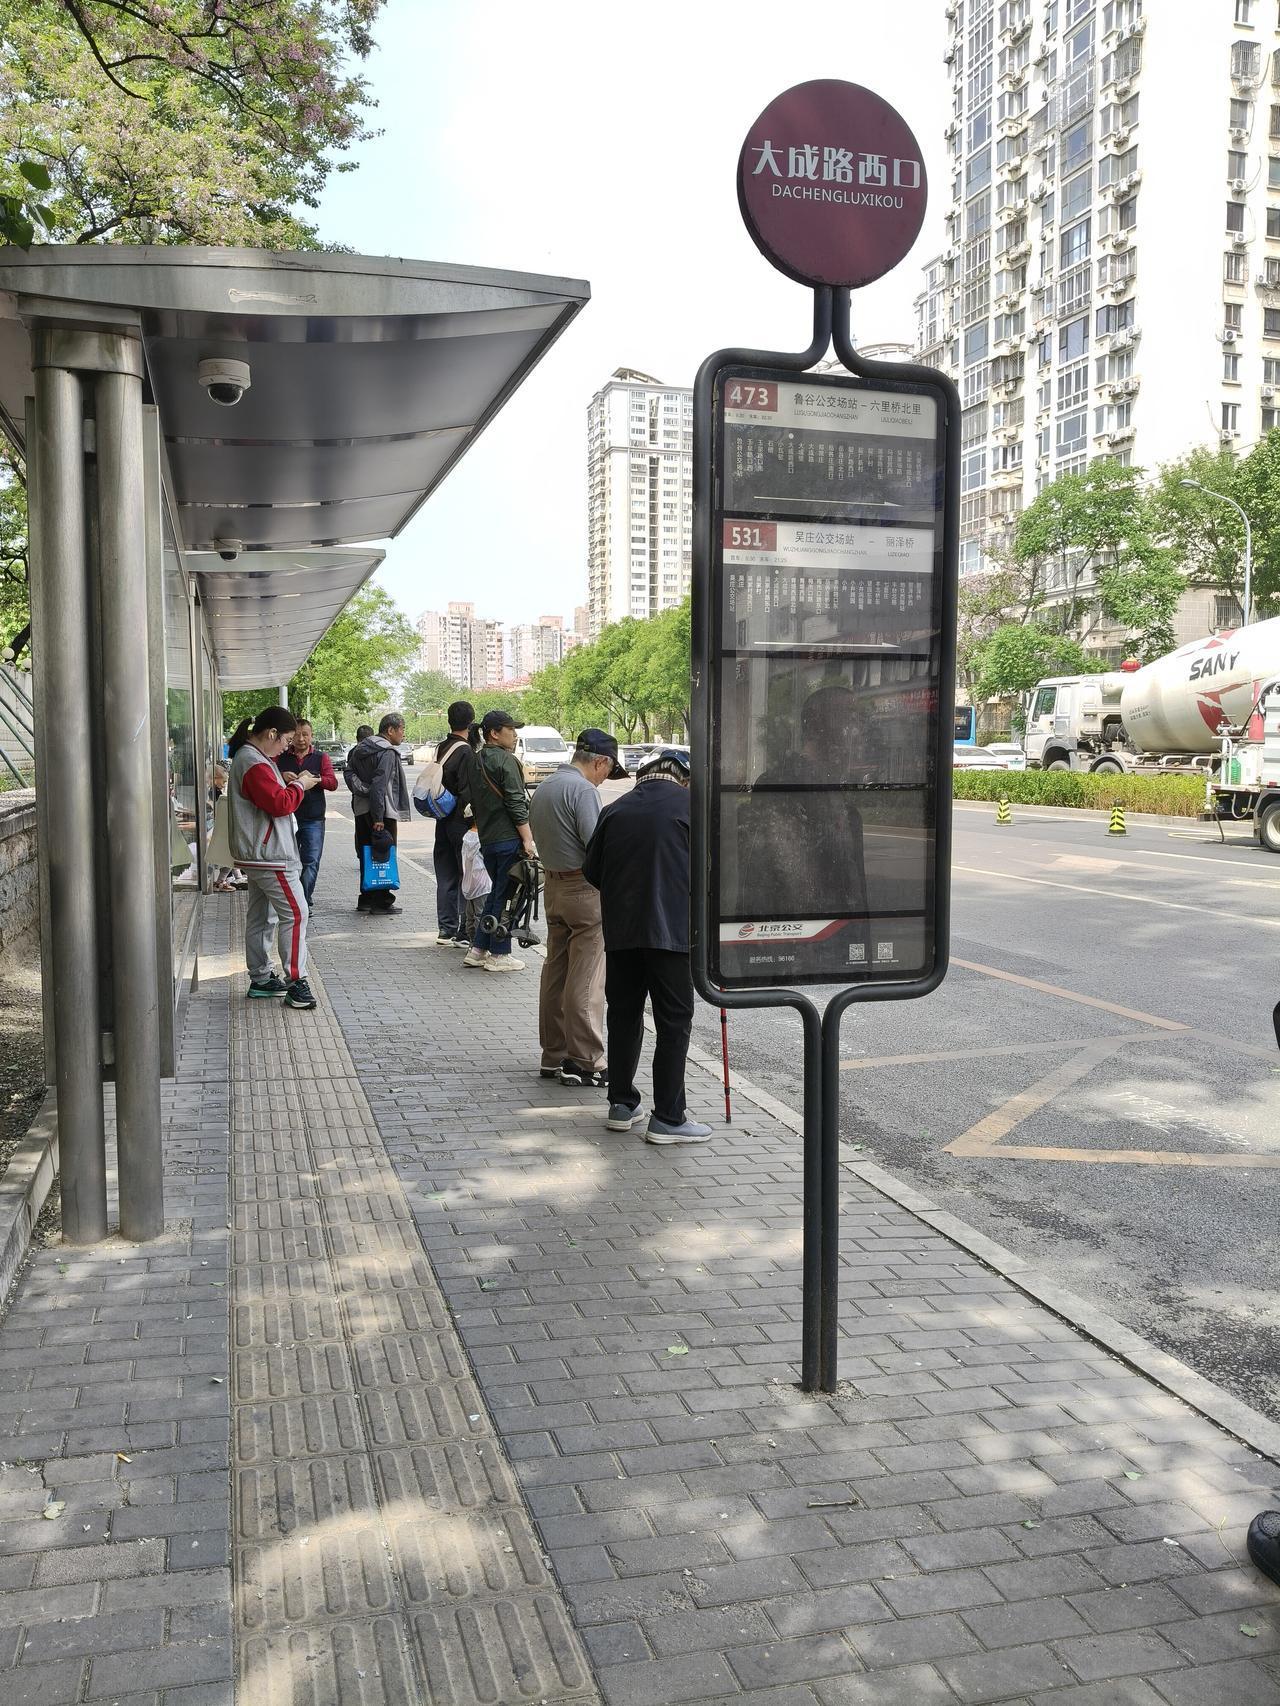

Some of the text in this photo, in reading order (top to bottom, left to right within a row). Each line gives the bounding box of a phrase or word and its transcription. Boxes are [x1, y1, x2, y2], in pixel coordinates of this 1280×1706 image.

[752, 140, 921, 189] 大成路西口
[772, 184, 904, 209] DACHENGLUXIKOU
[730, 386, 769, 406] 473
[794, 392, 858, 410] 鲁谷公交场站
[870, 400, 922, 415] 六里桥北里
[732, 527, 762, 546] 531
[795, 531, 855, 545] 吴庄公交场站
[885, 536, 915, 549] 丽泽桥
[1189, 651, 1240, 680] SANY
[758, 923, 803, 932] 北京公交
